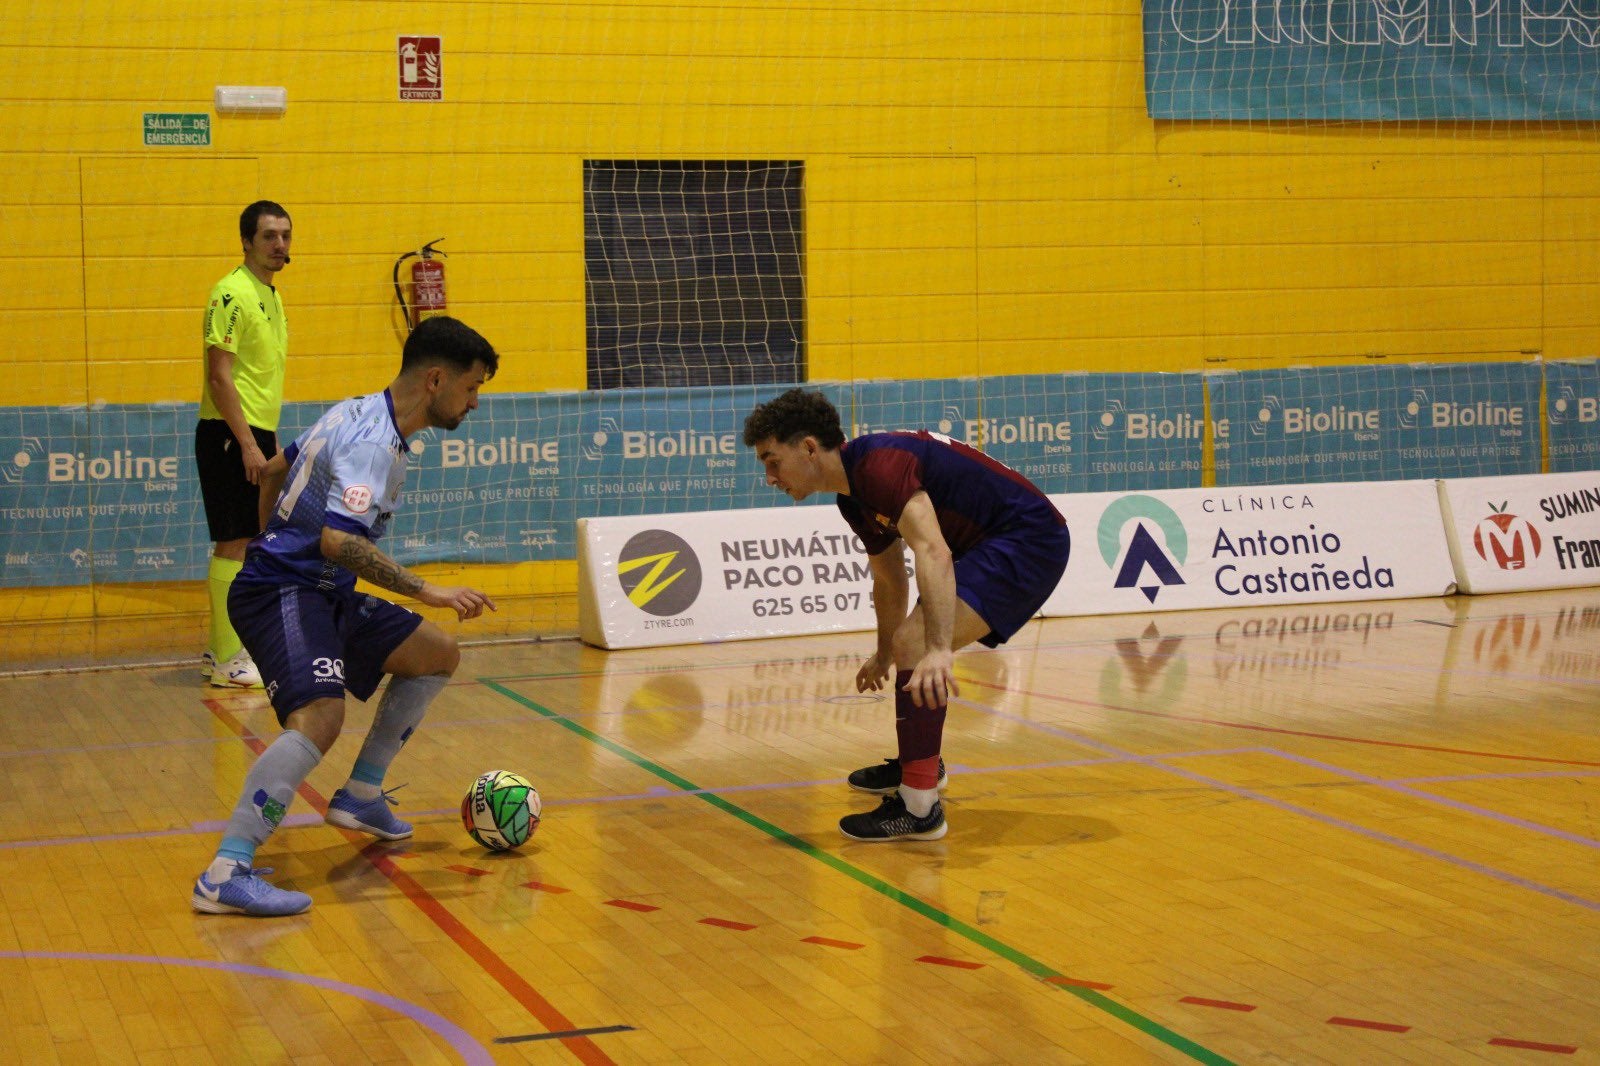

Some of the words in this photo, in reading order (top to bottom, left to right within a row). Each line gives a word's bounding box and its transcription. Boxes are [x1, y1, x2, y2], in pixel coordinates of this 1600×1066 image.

[148, 118, 182, 129] SALIDA
[193, 119, 206, 129] DE
[147, 133, 207, 144] EMERGENCIA
[1432, 402, 1523, 428] Bioline
[1578, 398, 1600, 422] B
[1128, 413, 1229, 439] Bioline
[1284, 406, 1380, 433] Bioline
[965, 416, 1070, 446] Bioline
[1355, 432, 1379, 441] Iberia
[623, 429, 736, 458] Bioline
[1044, 444, 1071, 454] Iberia
[1200, 442, 1230, 450] Ieria
[441, 436, 559, 468] Bioline
[1314, 454, 1334, 463] QUE
[1460, 447, 1478, 457] QUE
[1482, 446, 1521, 457] PROTEGE
[49, 450, 177, 482] Bioline
[707, 458, 736, 468] Iberia
[1027, 464, 1072, 474] PROTEGE
[1180, 460, 1230, 470] PROEGE
[529, 466, 559, 475] Iberia
[145, 482, 177, 491] Iberia
[660, 480, 681, 491] QUE
[688, 478, 736, 490] PROTEGE
[480, 489, 502, 500] QUE
[507, 486, 560, 498] PROTEGE
[90, 504, 115, 516] QUE
[121, 503, 178, 515] PROTEGE
[1203, 495, 1314, 512] CLÍNICA
[721, 531, 907, 562] NEUMÁTIC
[1212, 524, 1340, 558] Antonio
[723, 565, 804, 590] PACO
[812, 558, 915, 584] RAMS
[1215, 556, 1394, 596] Castañeda
[752, 598, 794, 617] 625
[800, 595, 828, 614] 65
[834, 592, 860, 611] 07
